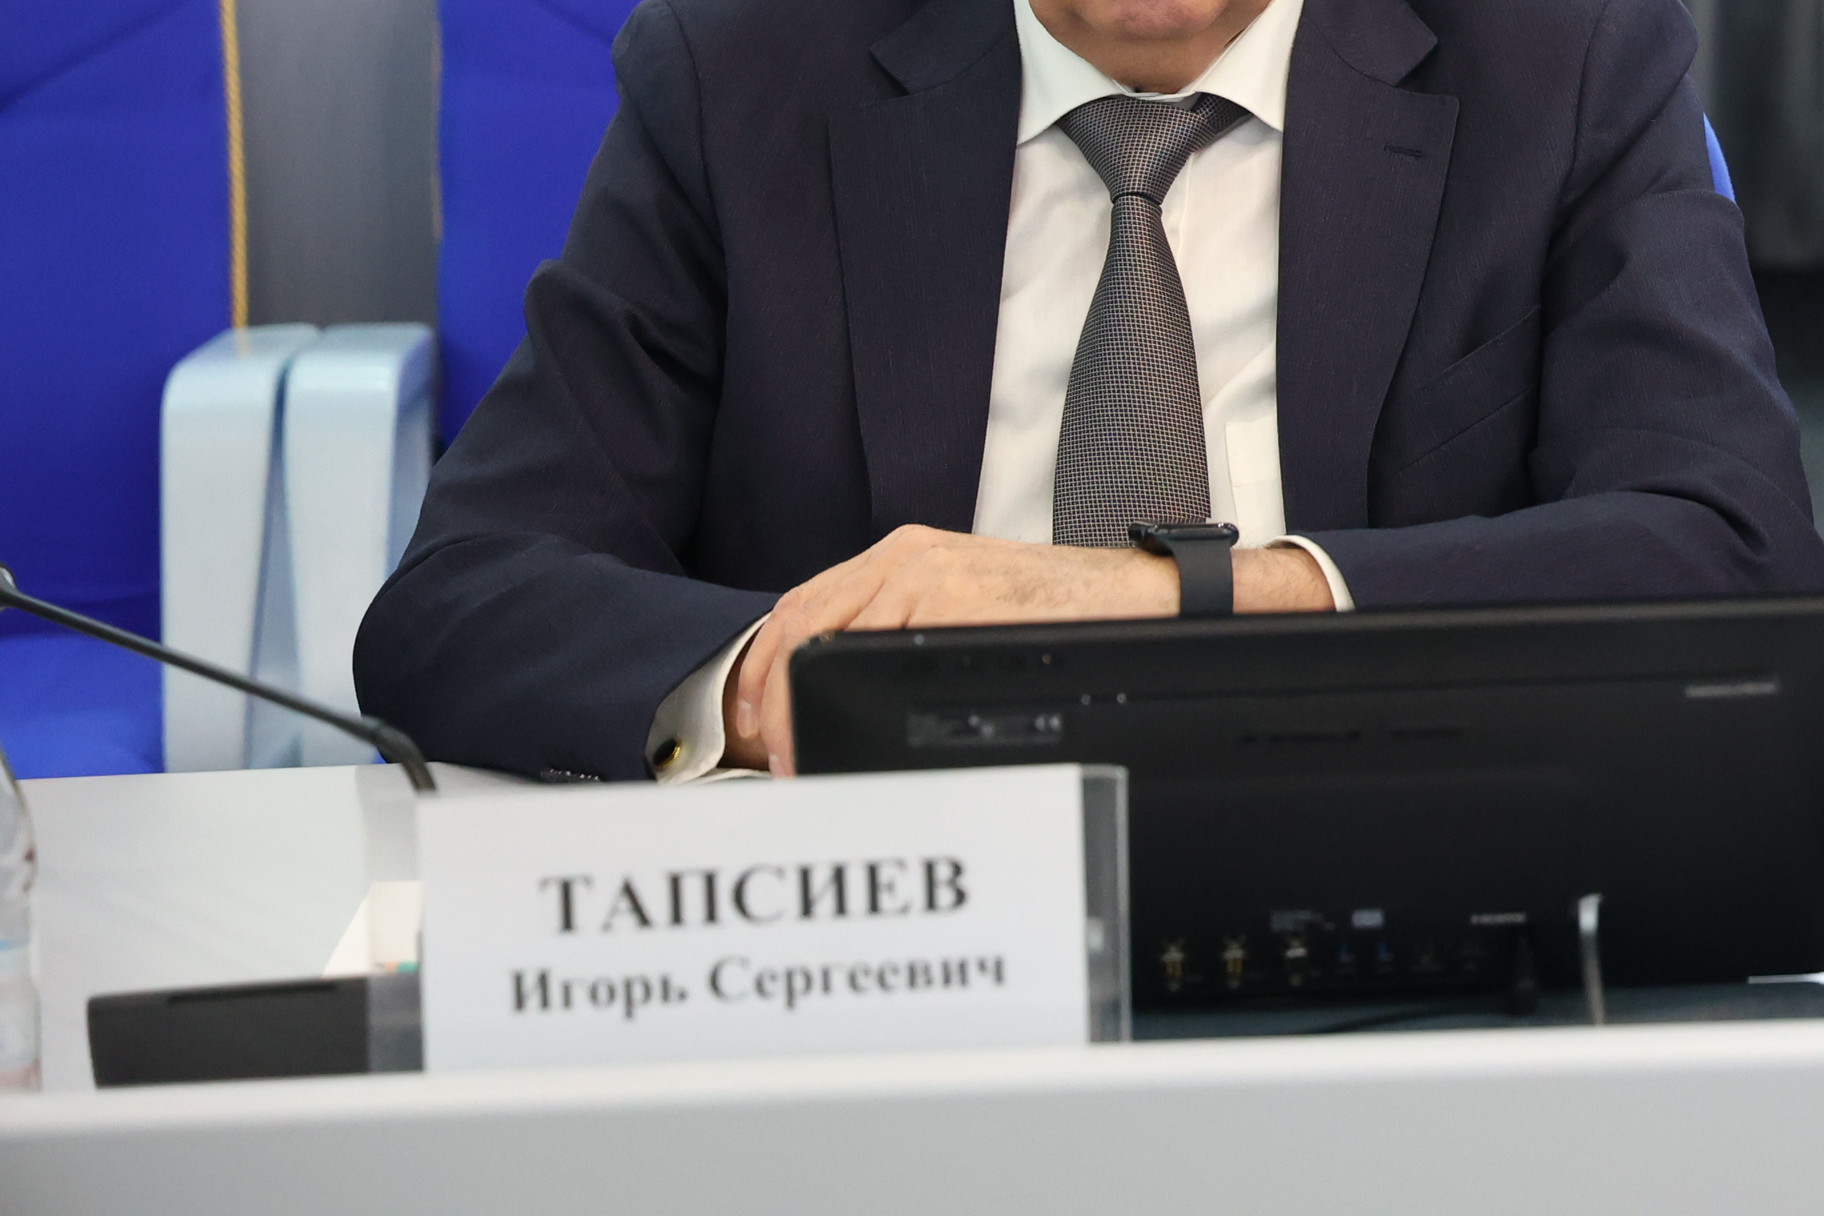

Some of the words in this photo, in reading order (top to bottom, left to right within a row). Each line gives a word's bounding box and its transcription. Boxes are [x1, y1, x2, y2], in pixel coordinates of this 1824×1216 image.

[540, 855, 971, 935] ТАПСИЕВ
[510, 966, 688, 1020] Игорь
[706, 953, 1008, 1011] Сергеевич
